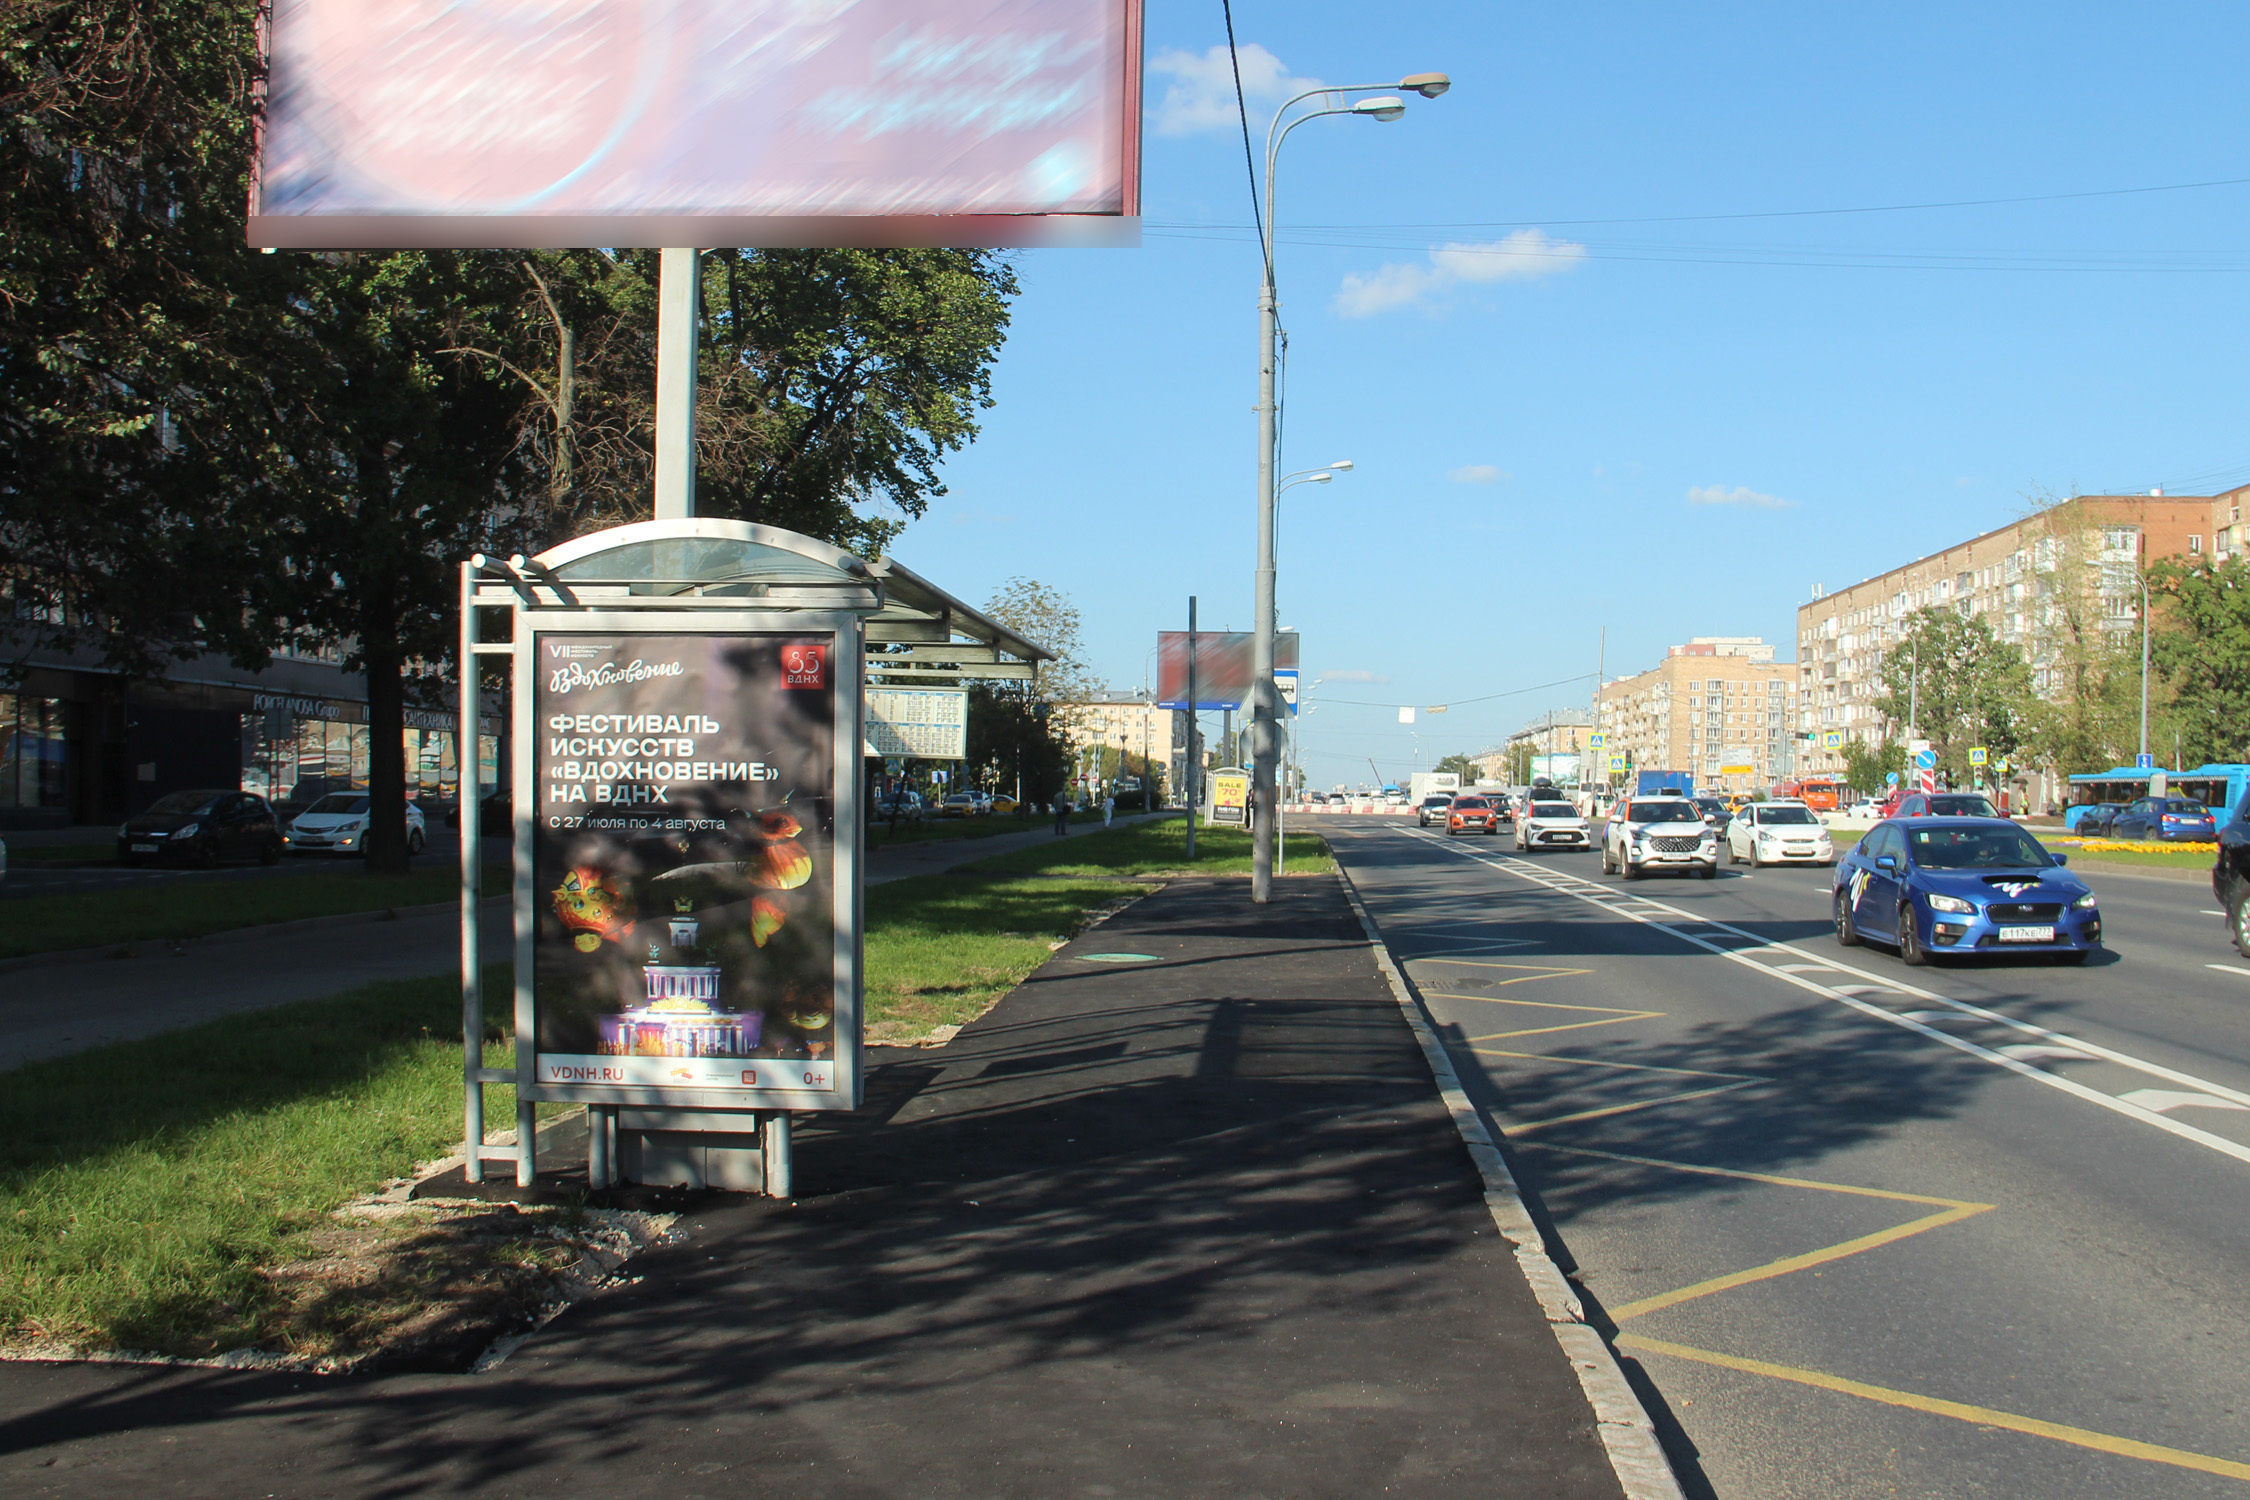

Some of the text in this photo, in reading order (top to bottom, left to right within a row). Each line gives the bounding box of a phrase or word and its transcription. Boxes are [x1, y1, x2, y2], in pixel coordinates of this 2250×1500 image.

[550, 645, 570, 658] VII
[788, 651, 819, 674] 85
[787, 674, 819, 684] ВДНХ
[315, 700, 340, 720] Grupo
[403, 710, 453, 730] САНТЕХНИКА
[549, 713, 720, 734] ФЕСТИВАЛЬ
[550, 737, 695, 758] ИСКУССТВ
[550, 761, 780, 783] «ВДОХНОВЕНИЕ»
[550, 784, 669, 806] НА ВДНХ
[565, 816, 583, 828] 27
[588, 817, 626, 829] июля
[629, 818, 648, 829] по
[651, 817, 662, 829] 4
[665, 818, 725, 832] августа
[551, 1066, 623, 1081] VDNH.RU
[803, 1072, 825, 1084] 0+
